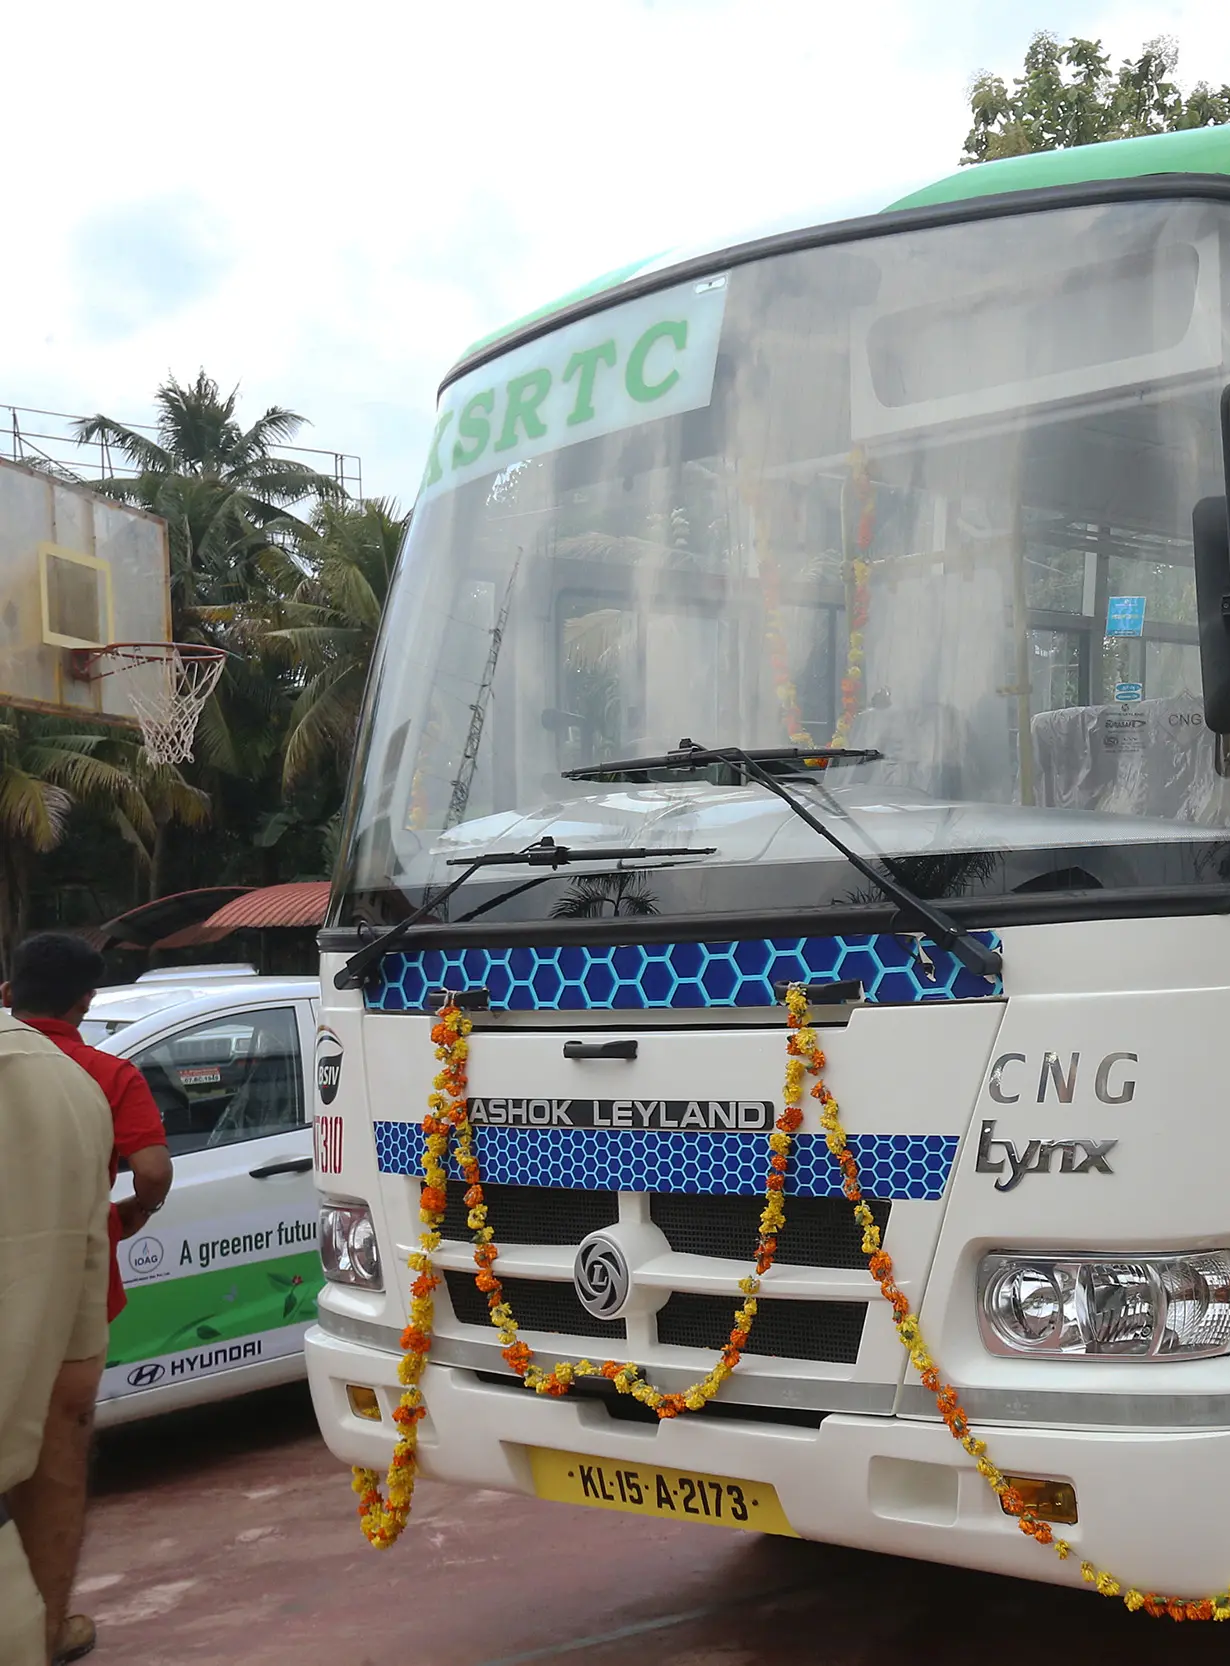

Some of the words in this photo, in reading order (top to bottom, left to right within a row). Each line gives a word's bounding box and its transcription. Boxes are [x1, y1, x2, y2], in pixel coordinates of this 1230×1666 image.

[1168, 713, 1202, 727] CNG
[987, 1051, 1140, 1105] CNG
[468, 1099, 574, 1127] ASHOK
[593, 1100, 768, 1130] LEYLAND
[134, 1254, 158, 1267] IOAG
[179, 1239, 193, 1266] A
[199, 1230, 273, 1268] greener
[171, 1340, 262, 1376] HYUNDAI
